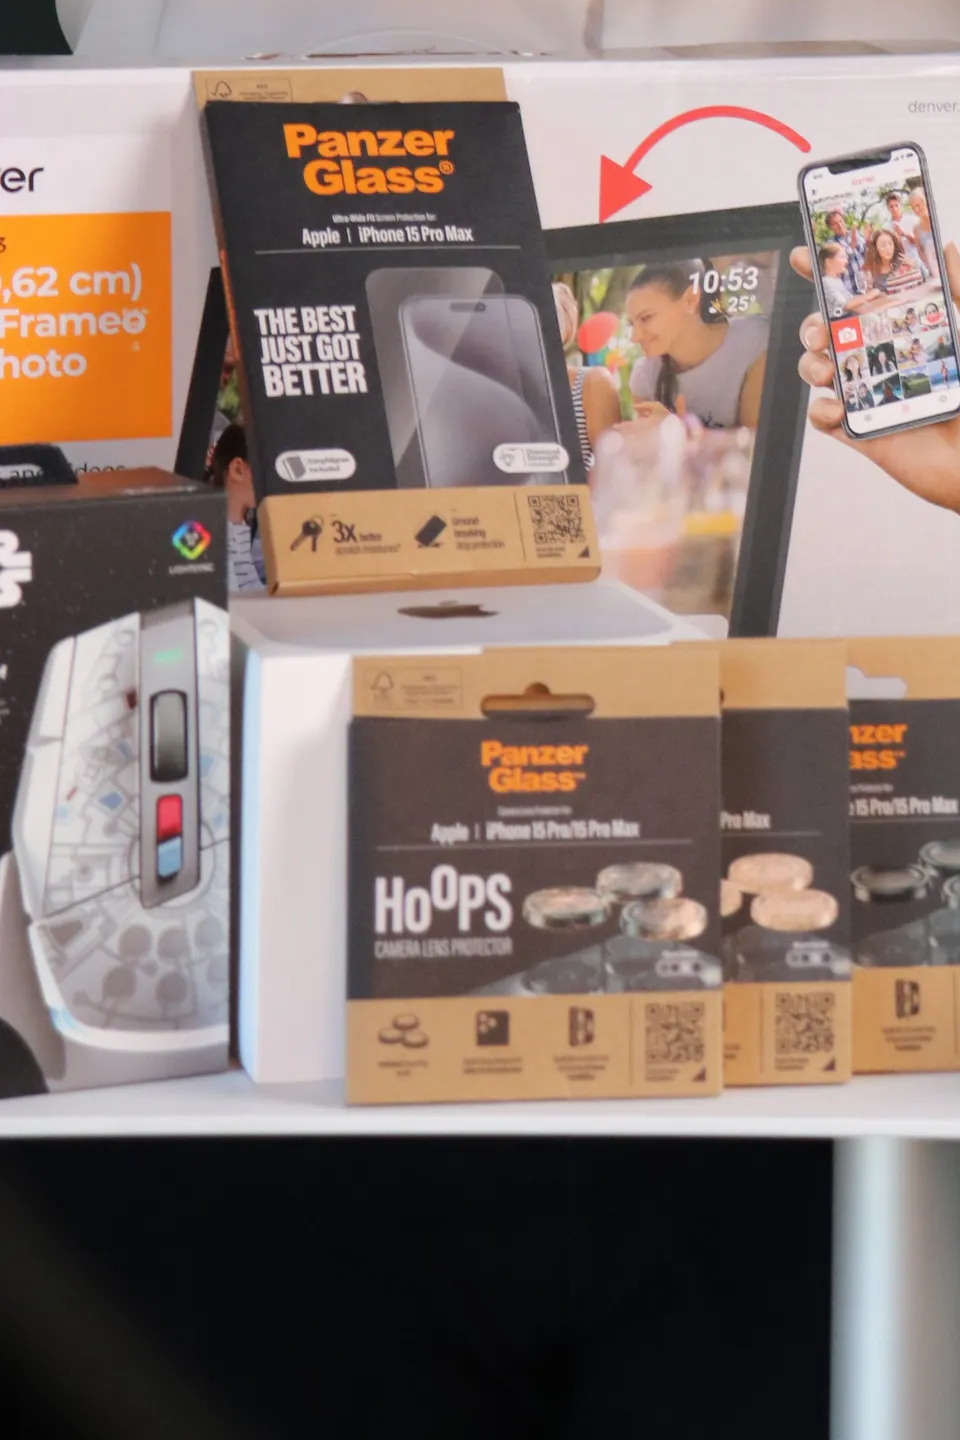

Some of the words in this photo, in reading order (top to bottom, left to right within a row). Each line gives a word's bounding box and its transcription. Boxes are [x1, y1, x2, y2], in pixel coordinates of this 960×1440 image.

[282, 122, 456, 159] Panzer
[302, 227, 341, 248] Apple
[358, 225, 405, 243] iPhone
[406, 226, 420, 242] 15
[422, 226, 444, 242] Pro
[445, 225, 474, 242] Max
[69, 261, 143, 302] cm)
[688, 265, 760, 296] 10:53
[253, 307, 300, 336] THE
[300, 305, 356, 334] BEST
[260, 334, 313, 364] JUST
[315, 333, 361, 362] GOT
[262, 361, 369, 398] BETTER
[331, 519, 358, 544] 3x
[480, 739, 590, 766] Panzer
[856, 800, 868, 816] 15
[910, 796, 931, 815] Pro
[931, 795, 960, 814] Max
[430, 821, 470, 846] Apple
[485, 820, 531, 841] iPhone
[531, 820, 546, 840] 15
[588, 818, 611, 839] Pro
[611, 818, 641, 838] Max
[719, 811, 743, 830] Pro
[743, 810, 772, 830] Max
[374, 939, 421, 959] CAMERA
[421, 938, 450, 959] LENS
[450, 937, 514, 957] PROTECTOR
